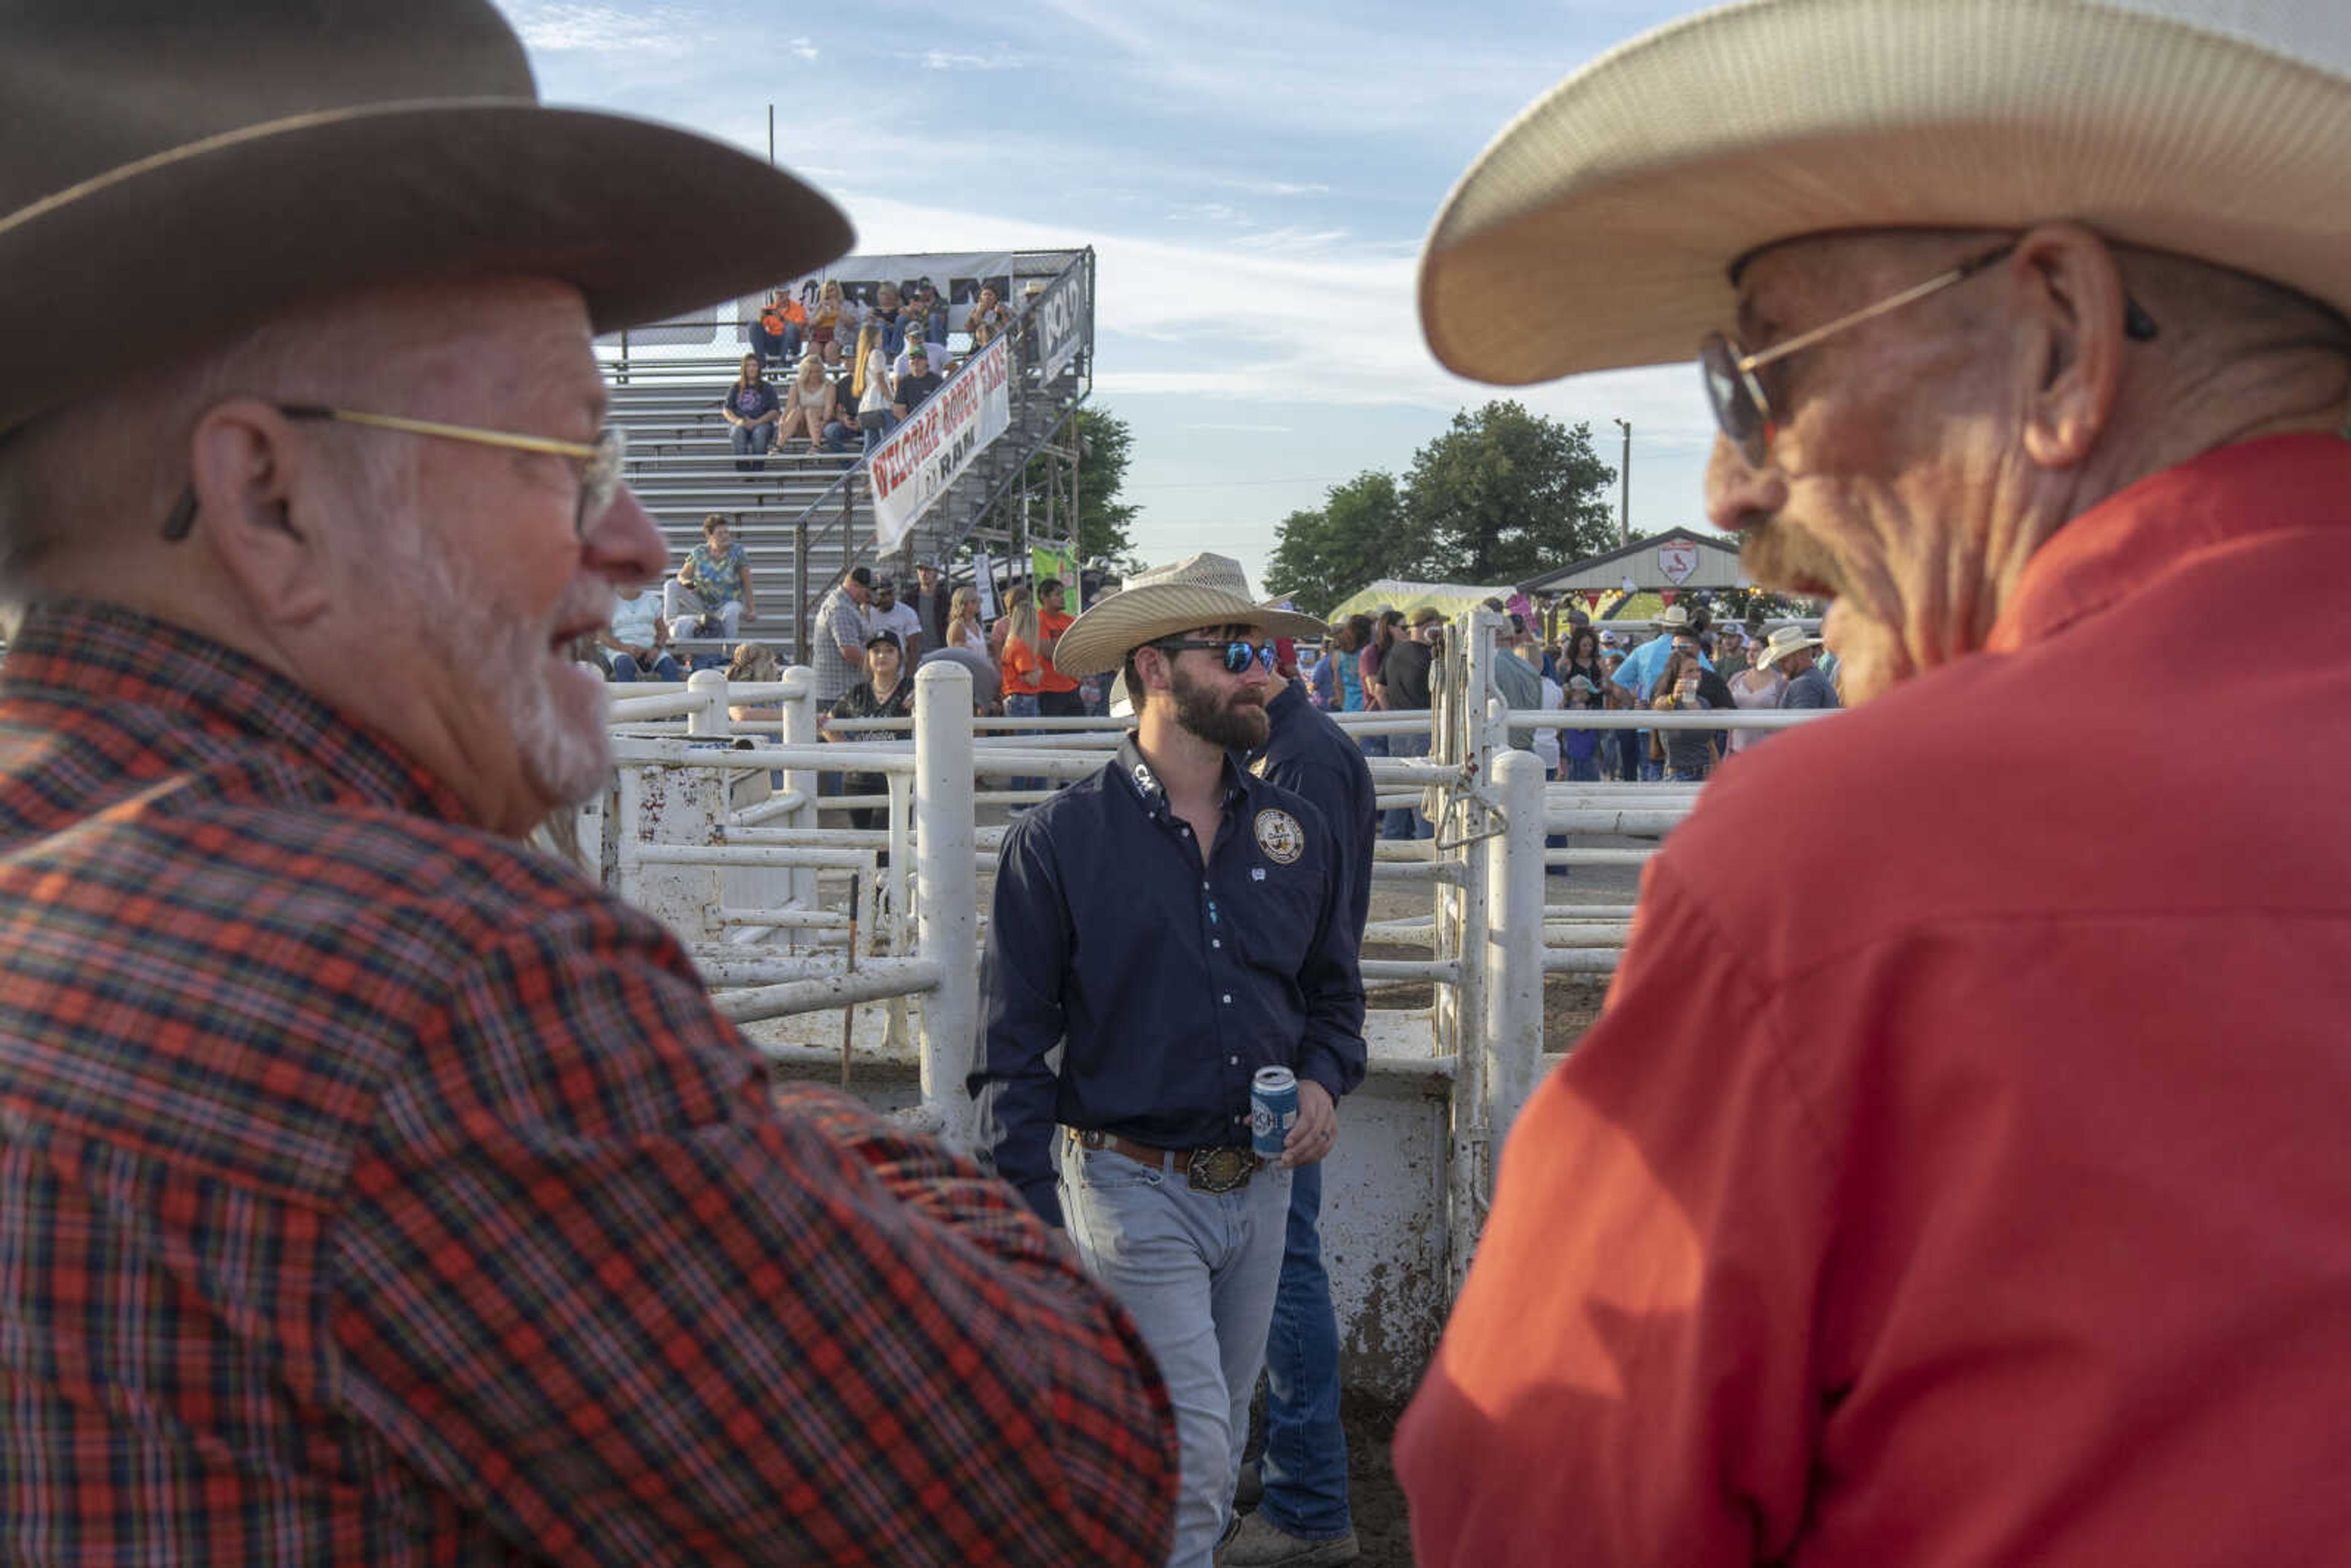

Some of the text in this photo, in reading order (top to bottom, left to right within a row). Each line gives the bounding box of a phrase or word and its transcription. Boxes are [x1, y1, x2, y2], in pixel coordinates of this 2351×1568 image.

[840, 277, 1010, 307] RM
[872, 406, 940, 501] WELCOME
[942, 370, 978, 437] RODEO
[940, 426, 975, 482] RAM
